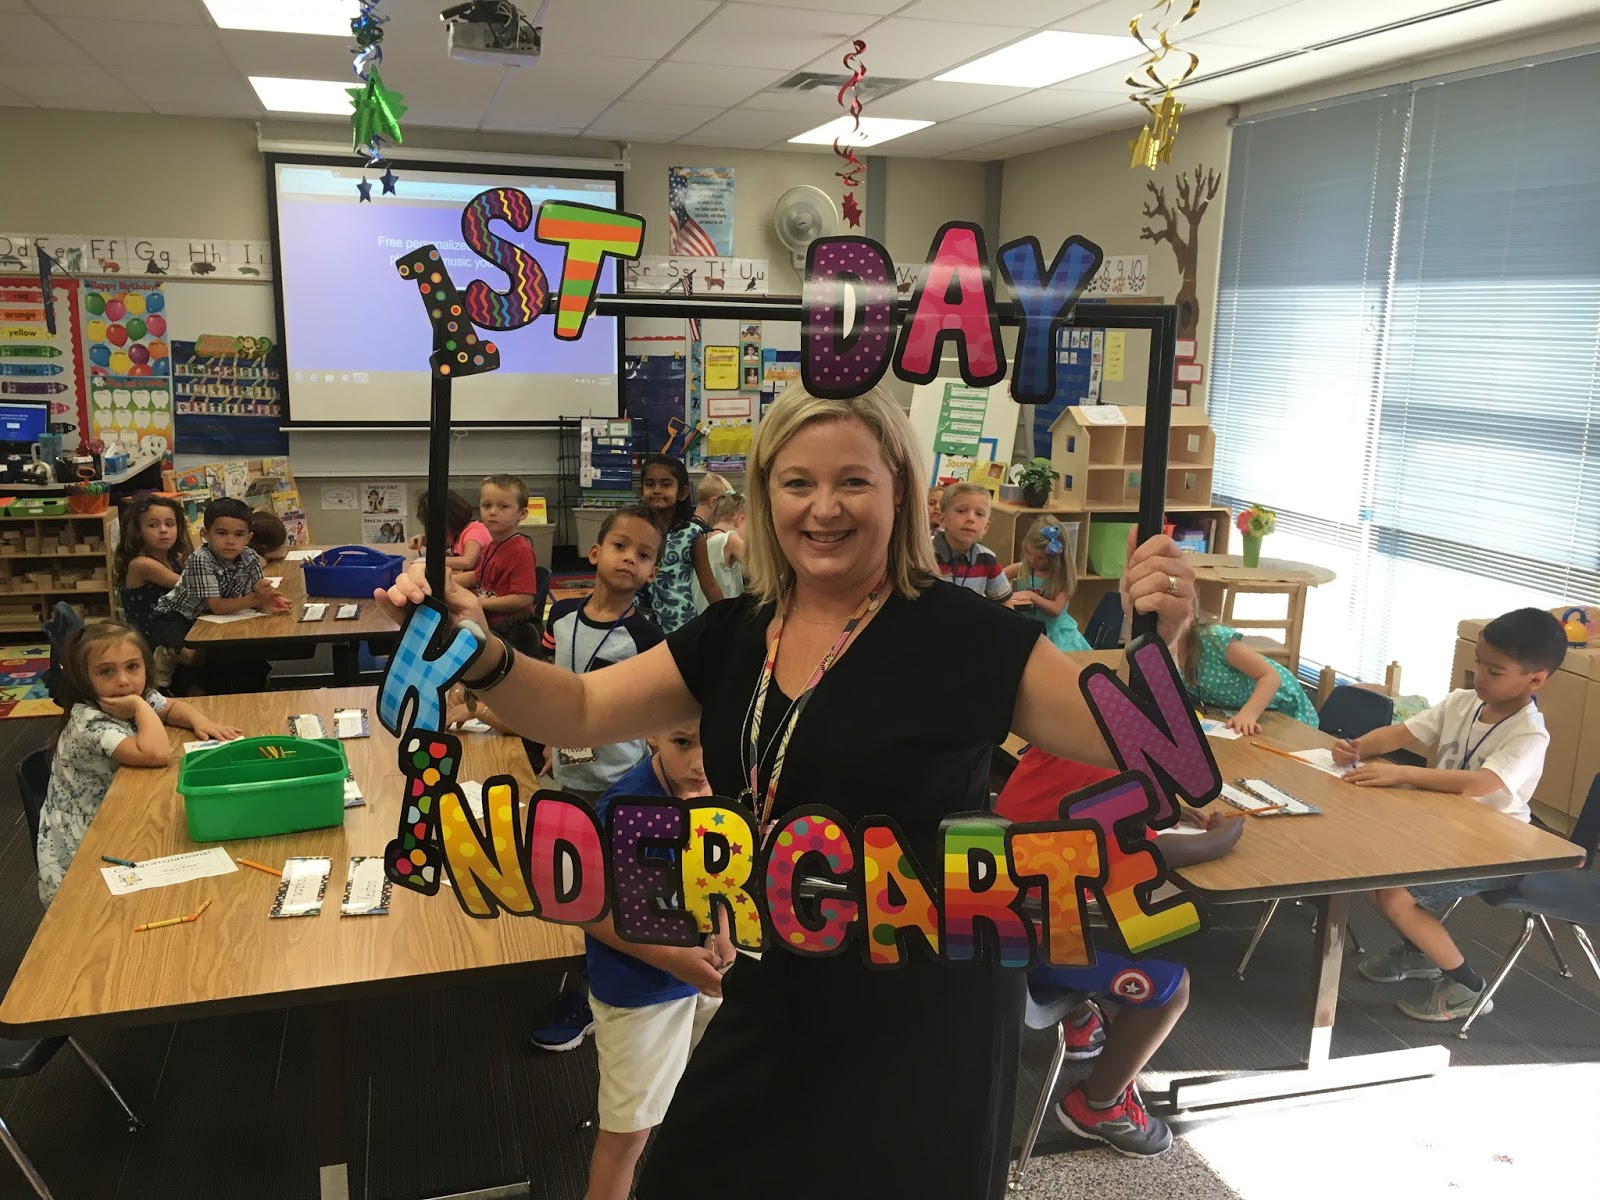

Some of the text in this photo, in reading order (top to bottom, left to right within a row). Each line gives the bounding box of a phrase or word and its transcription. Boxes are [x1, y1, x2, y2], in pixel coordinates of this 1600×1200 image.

[377, 235, 467, 251] Free persnalize
[444, 254, 472, 268] music
[89, 281, 117, 292] Happy
[14, 292, 28, 300] red
[5, 311, 36, 320] orange
[801, 221, 1104, 404] DAY
[8, 328, 37, 338] yellow
[14, 348, 38, 356] green
[19, 366, 37, 374] blue
[375, 598, 1223, 970] KINDERGARTEN
